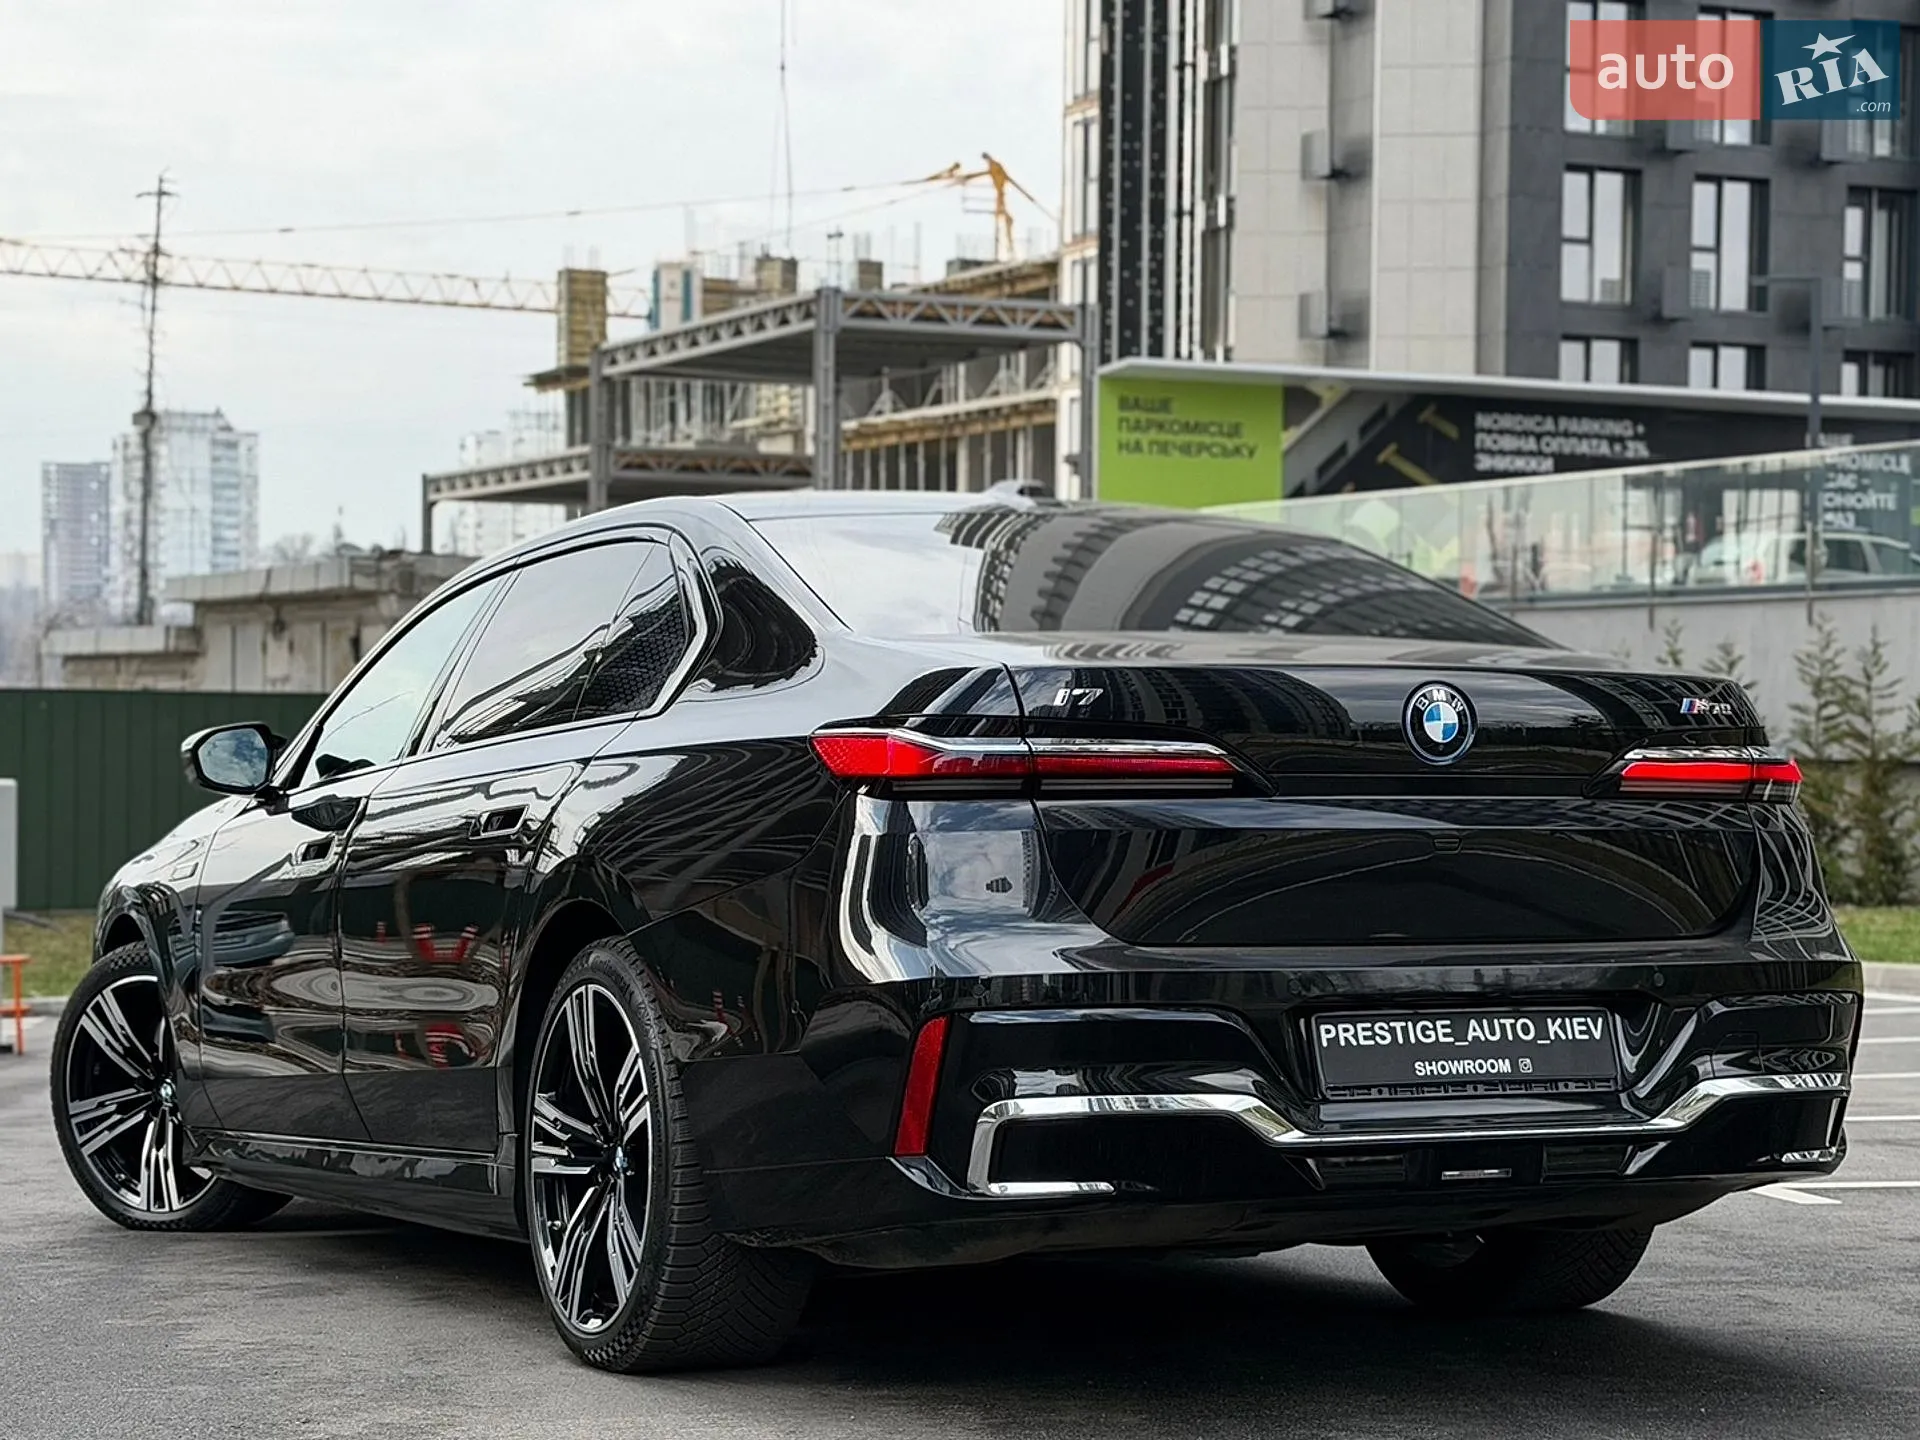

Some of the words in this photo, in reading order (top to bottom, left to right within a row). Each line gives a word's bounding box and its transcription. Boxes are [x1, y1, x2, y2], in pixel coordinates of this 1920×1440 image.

[1117, 394, 1174, 415] ВАШЕ
[1117, 416, 1244, 439] ПАРКОМІСЦЕ
[1474, 412, 1556, 433] NORDICA
[1557, 416, 1635, 438] PARKING
[1117, 438, 1144, 456] НА
[1148, 440, 1258, 460] ПЕЧЕРСЬКУ
[1474, 432, 1539, 453] ПОВНА
[1539, 435, 1612, 457] ОПЛАТА
[1053, 687, 1104, 707] i7
[1415, 688, 1465, 713] BMW
[1319, 1016, 1603, 1048] PRESTIGE_AUTO_KIEV
[1413, 1057, 1512, 1077] SHOWROOM
